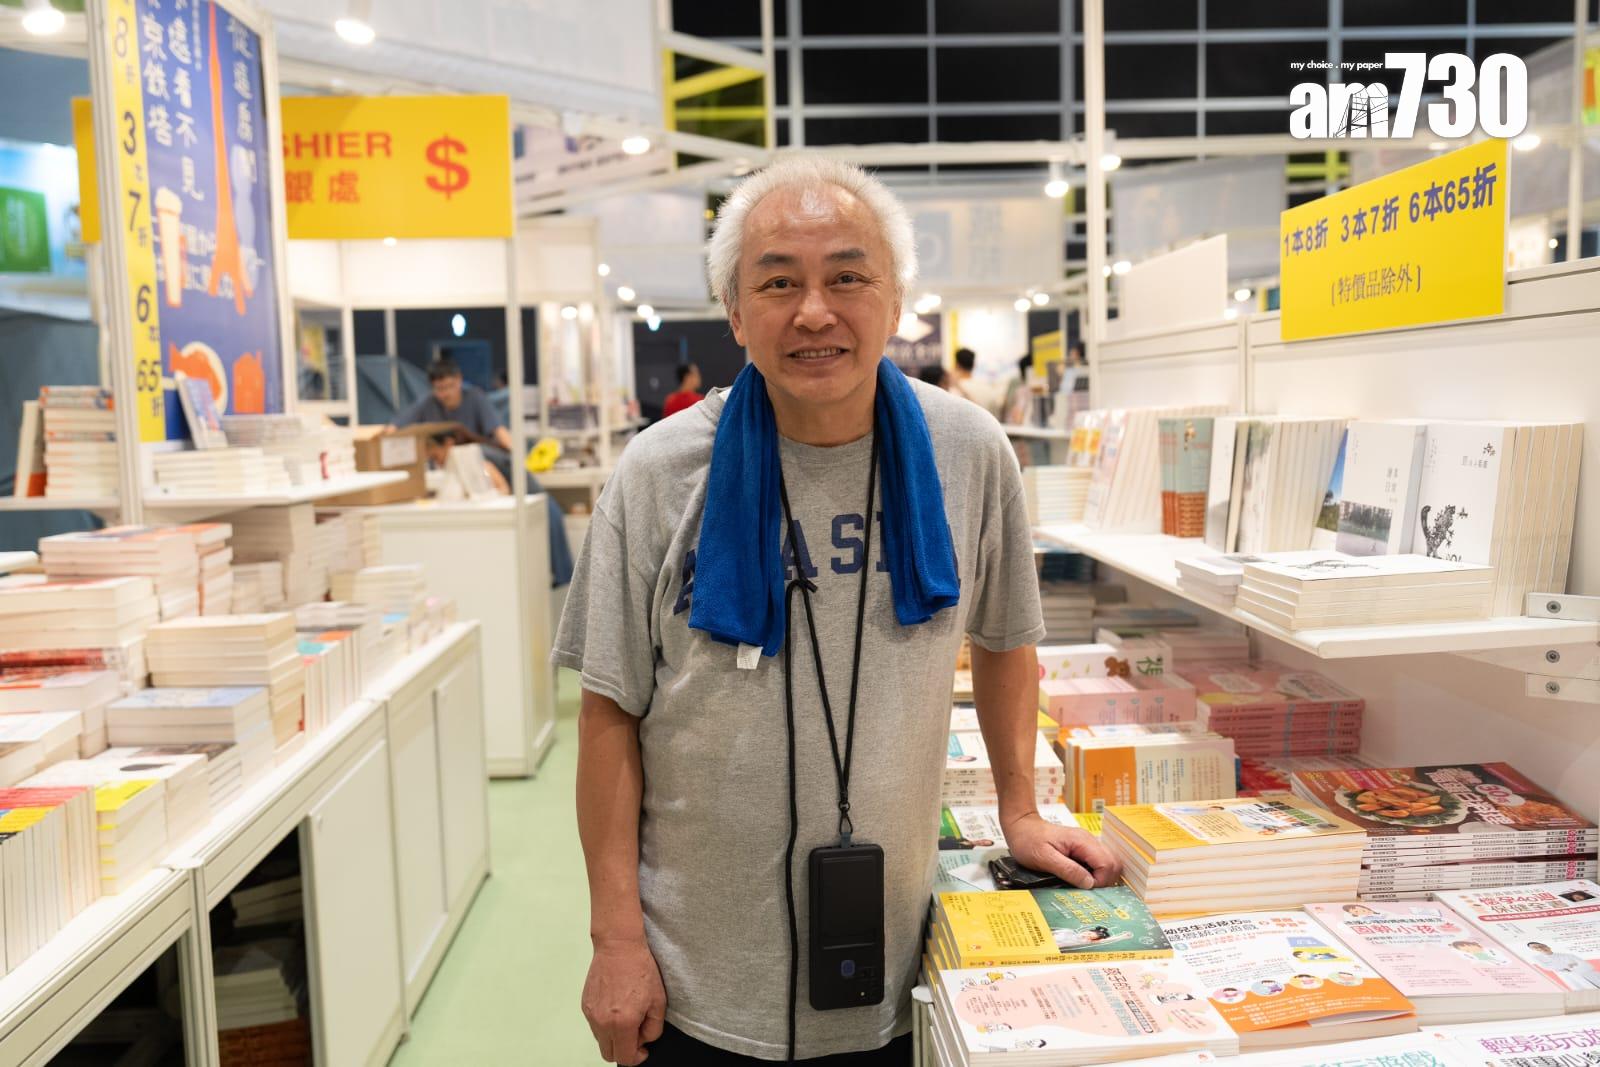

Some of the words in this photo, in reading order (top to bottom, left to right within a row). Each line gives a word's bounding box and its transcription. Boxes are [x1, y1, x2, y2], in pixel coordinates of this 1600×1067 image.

[1284, 217, 1329, 257] 1本8折
[1340, 195, 1400, 243] 3本7折
[1408, 162, 1497, 223] 6本65折
